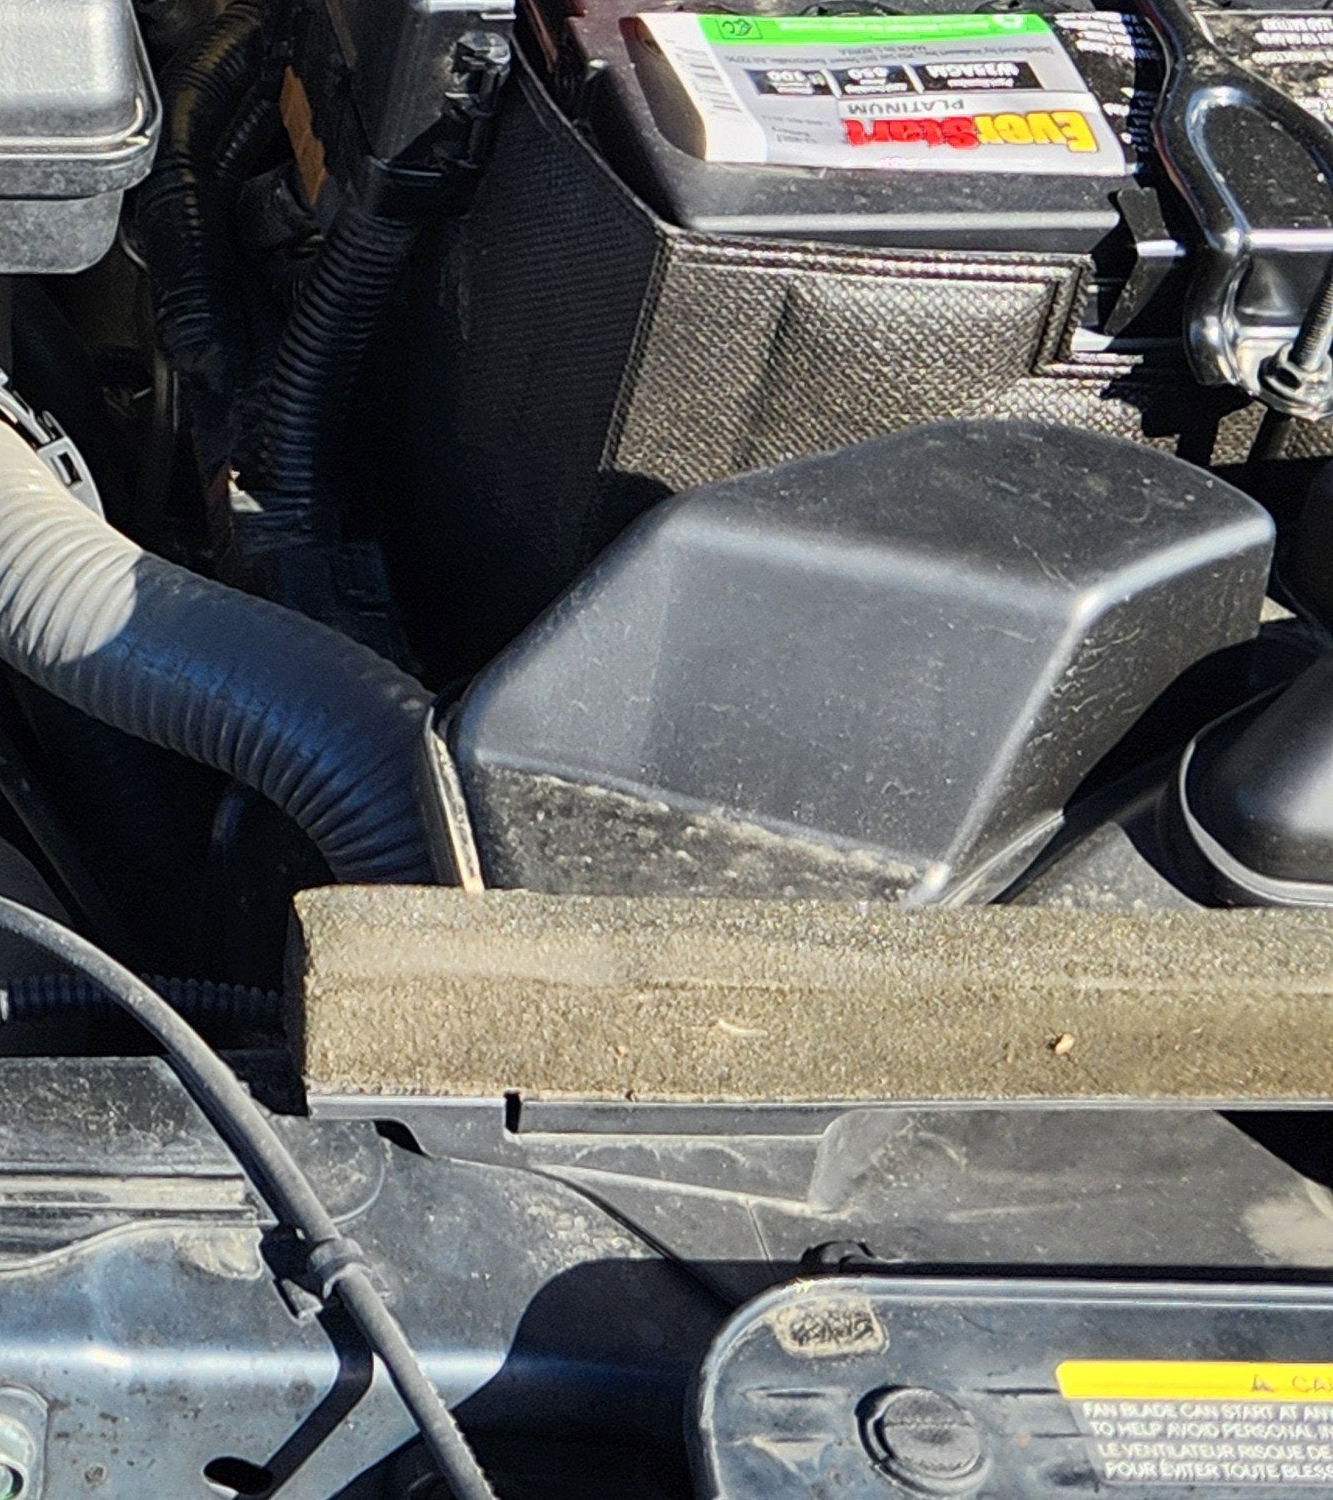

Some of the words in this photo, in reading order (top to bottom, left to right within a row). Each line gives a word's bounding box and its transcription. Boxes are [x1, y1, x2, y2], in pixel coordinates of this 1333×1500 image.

[848, 99, 965, 115] PLATINUM
[843, 111, 1099, 152] EverStart
[1083, 1401, 1118, 1418] FAN
[1120, 1402, 1178, 1419] BLADE
[1179, 1402, 1220, 1419] CAN
[1221, 1403, 1274, 1421] START
[1279, 1403, 1298, 1420] AT
[1090, 1421, 1115, 1437] TO
[1117, 1421, 1164, 1438] HELP
[1166, 1421, 1220, 1440] AVOID
[1221, 1422, 1317, 1440] PERSONAL
[1097, 1442, 1121, 1457] LE
[1121, 1443, 1235, 1459] VENTILATEUR
[1237, 1444, 1306, 1460] RISQUE
[1105, 1461, 1157, 1479] POUR
[1159, 1458, 1221, 1479] ÉVITER
[1222, 1462, 1280, 1479] TOUTE
